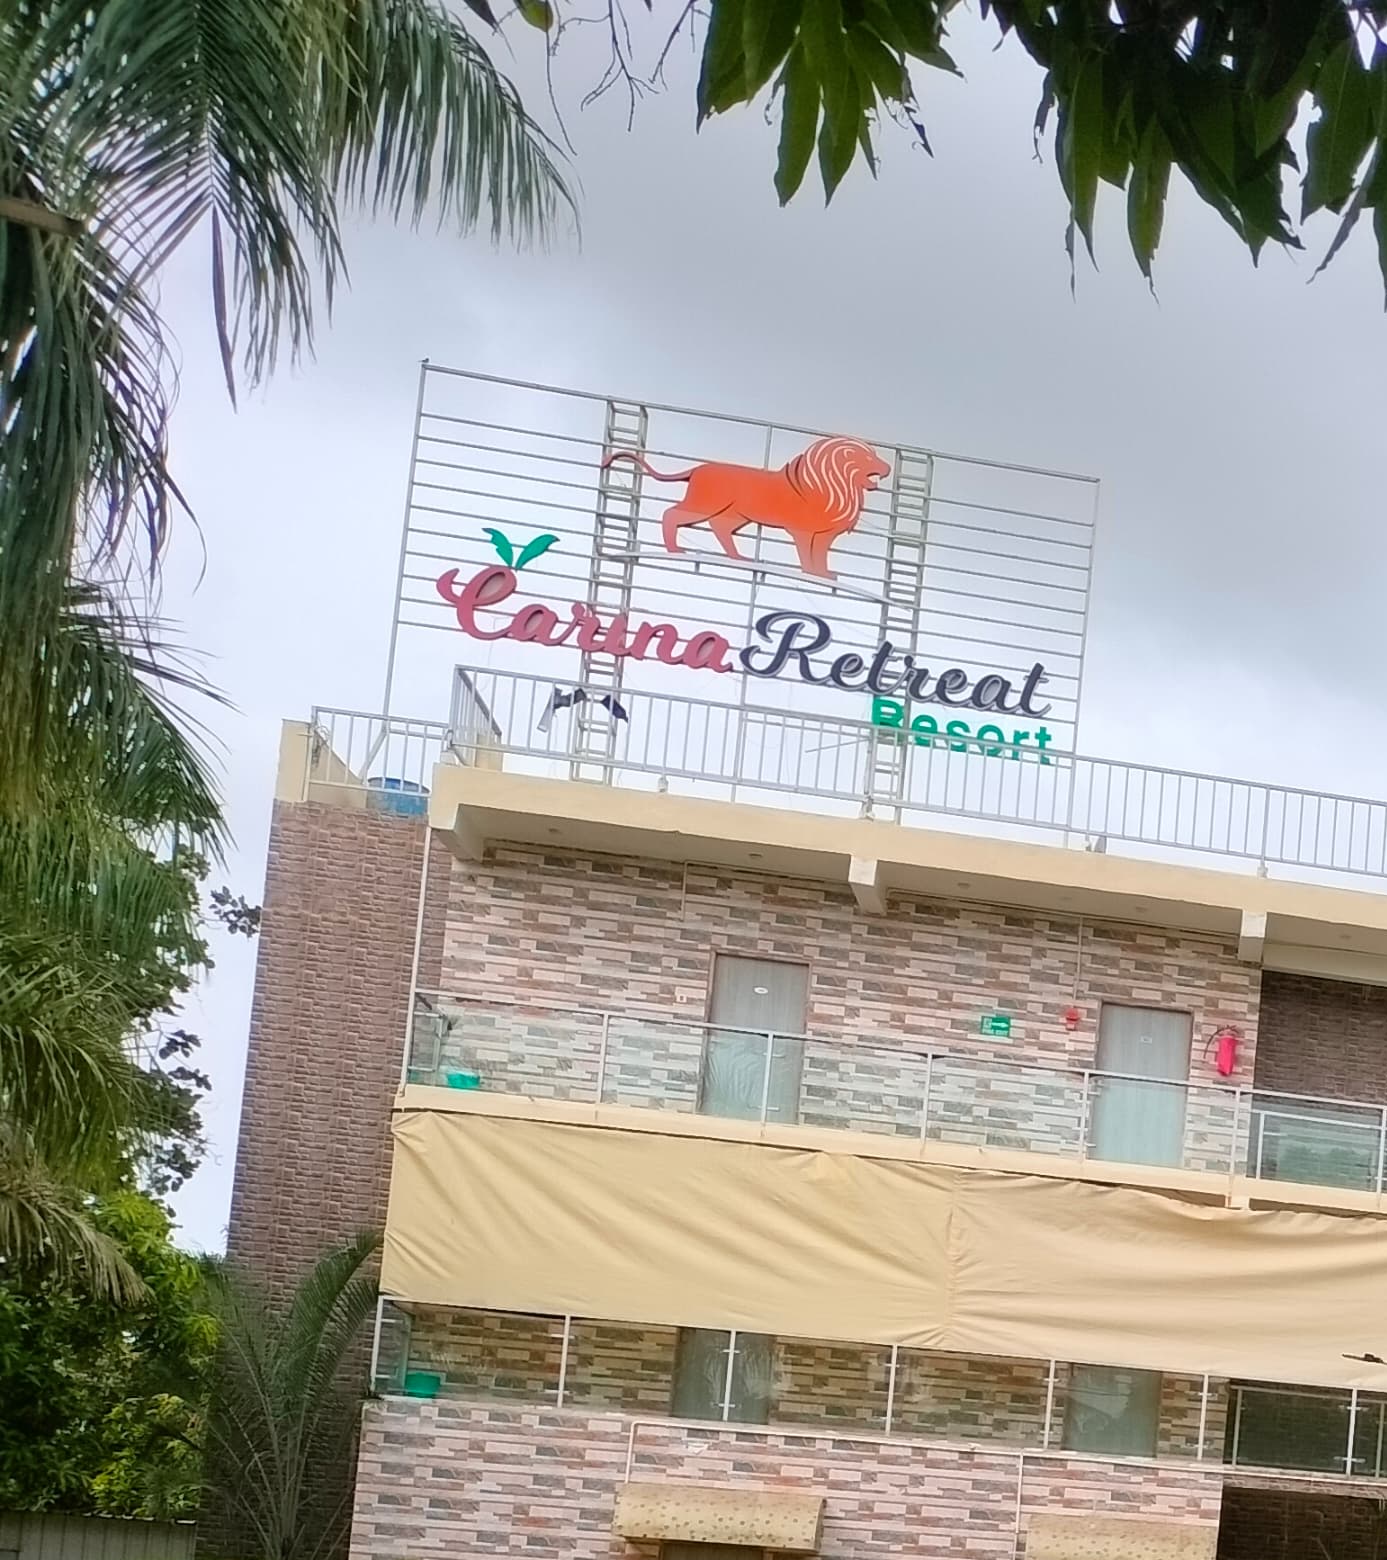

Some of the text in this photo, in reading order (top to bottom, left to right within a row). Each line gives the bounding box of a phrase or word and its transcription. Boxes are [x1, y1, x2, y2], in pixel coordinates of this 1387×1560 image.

[436, 564, 1052, 718] Carina Retreat
[872, 695, 1052, 765] Resort
